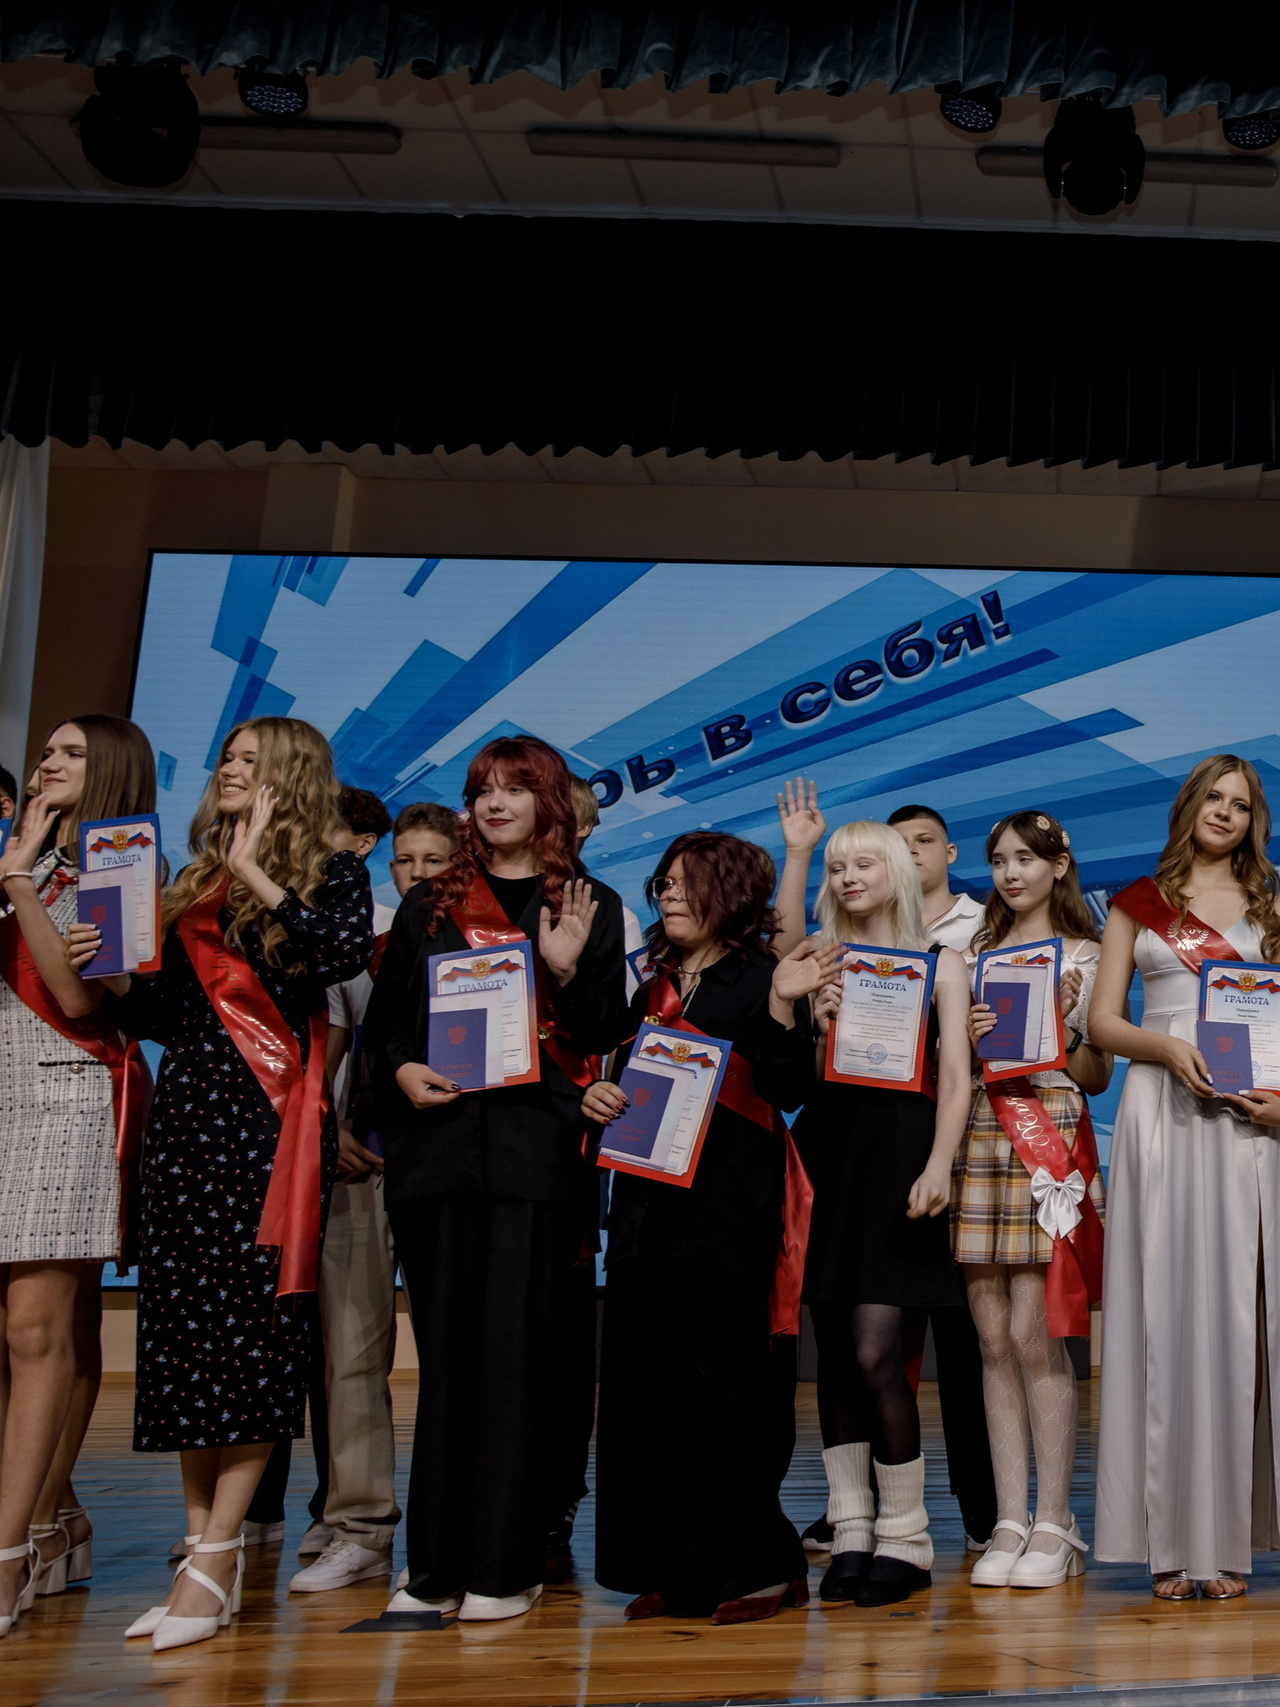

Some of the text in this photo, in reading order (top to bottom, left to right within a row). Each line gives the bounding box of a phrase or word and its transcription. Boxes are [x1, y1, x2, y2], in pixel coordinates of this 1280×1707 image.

[702, 713, 754, 762] в
[779, 590, 1012, 725] себя!
[102, 854, 142, 866] ГРАМОТА
[458, 979, 508, 993] ГРАМОТА
[859, 979, 907, 992] ГРАМОТА
[1224, 995, 1270, 1006] ГРАМОТА
